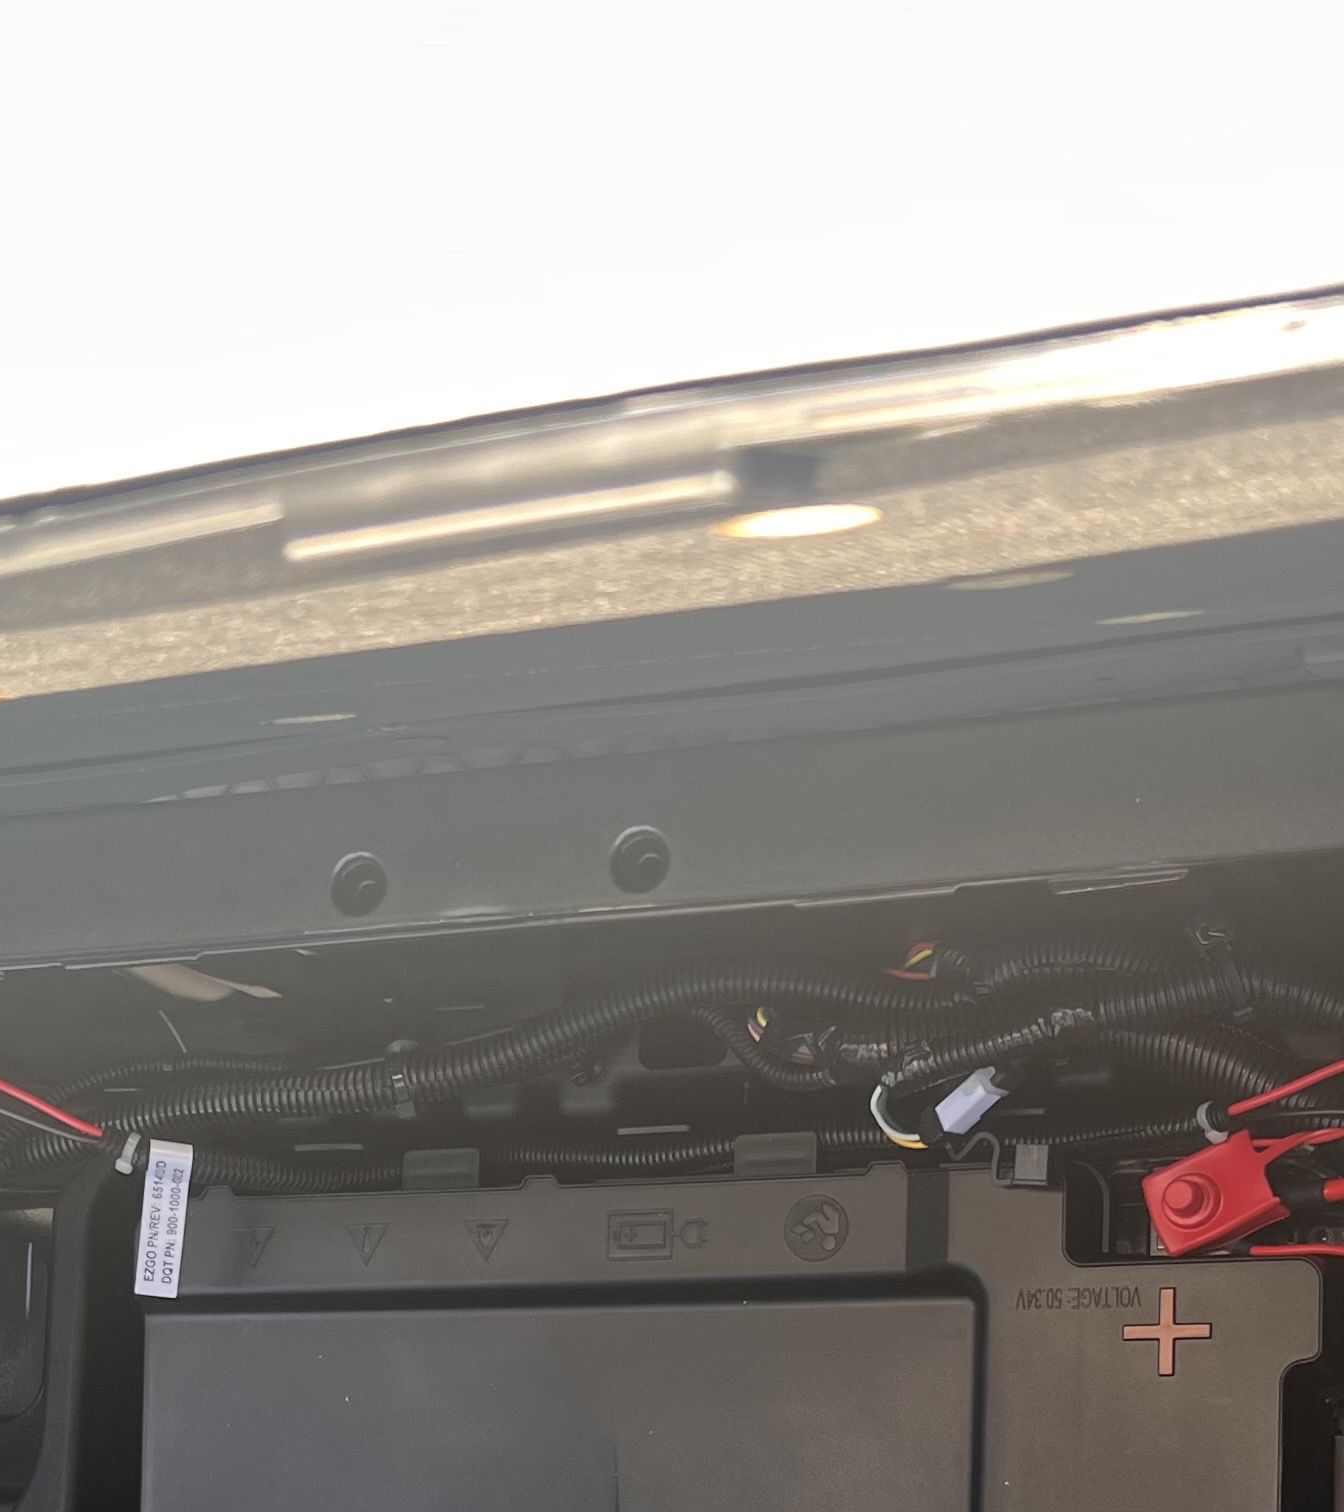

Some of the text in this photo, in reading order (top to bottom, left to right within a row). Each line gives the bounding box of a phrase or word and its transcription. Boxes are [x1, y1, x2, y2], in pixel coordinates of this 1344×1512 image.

[143, 1251, 157, 1282] EZGO
[161, 1261, 173, 1284] DQT
[1015, 1286, 1141, 1311] VOLTAGE: 50.34V
